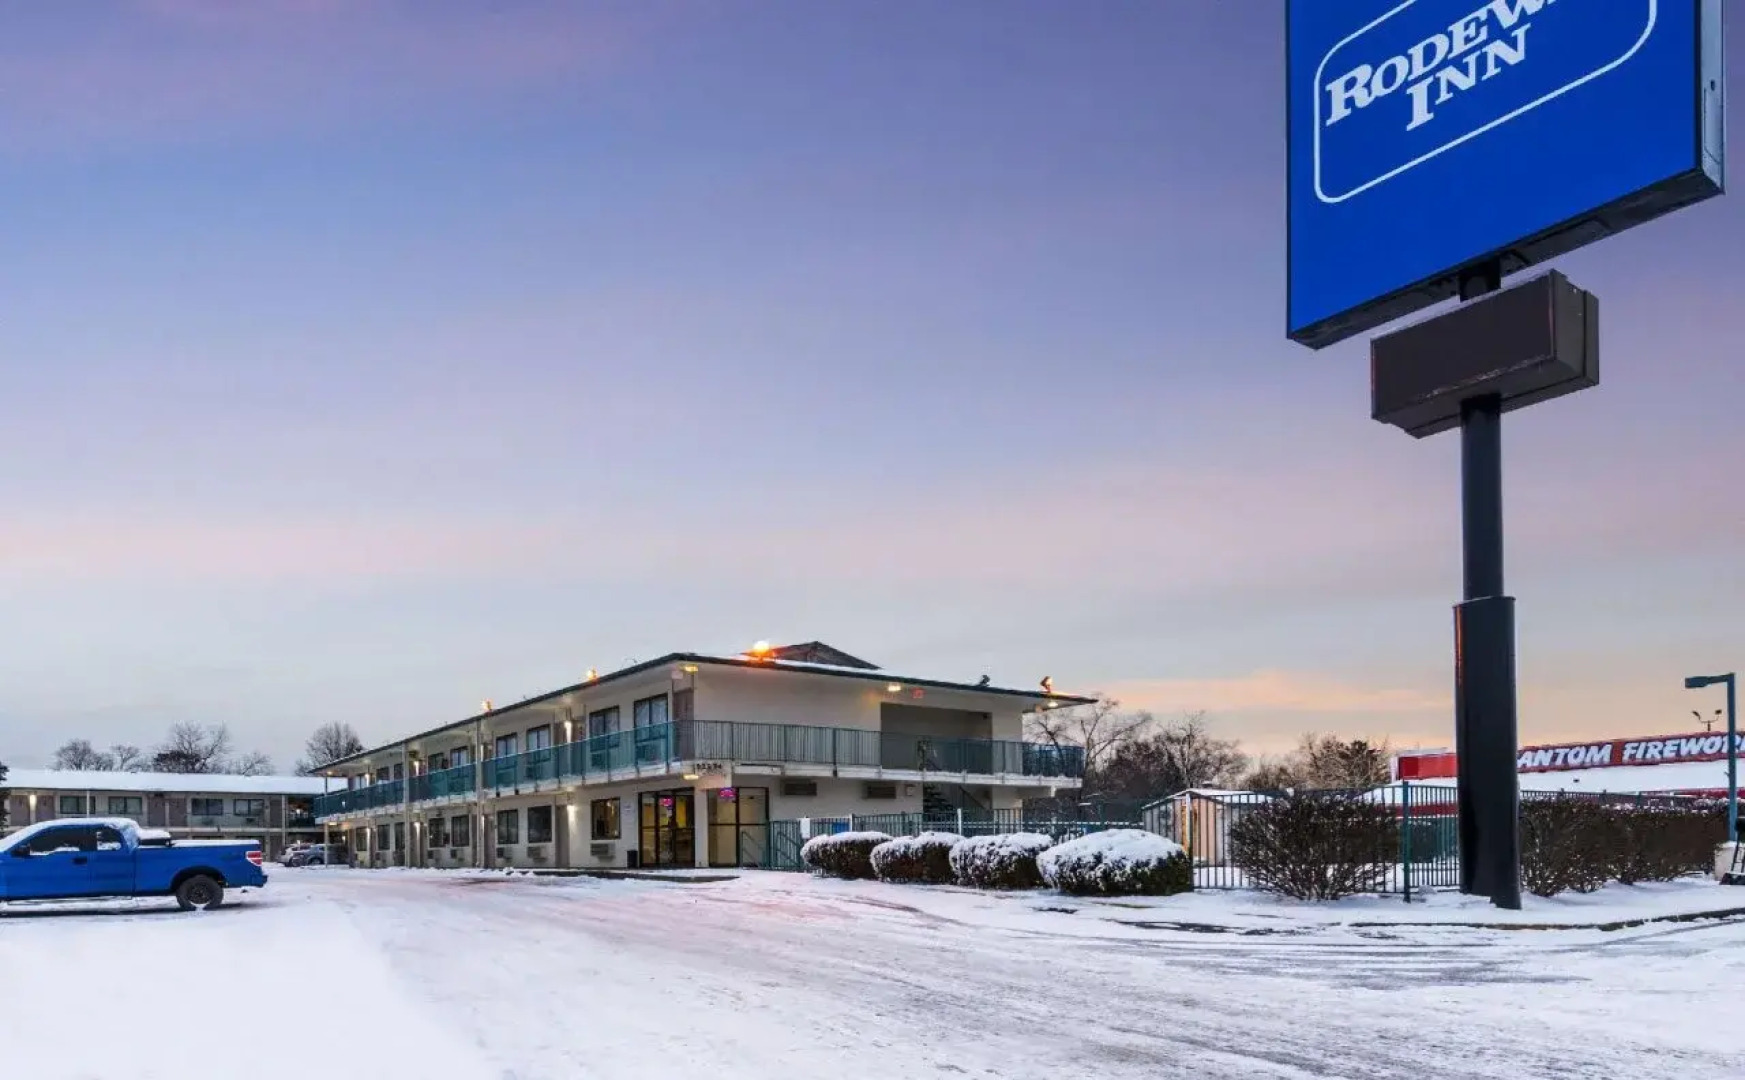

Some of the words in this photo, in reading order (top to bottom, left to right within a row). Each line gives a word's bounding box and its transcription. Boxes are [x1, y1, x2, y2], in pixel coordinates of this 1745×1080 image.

[1325, 0, 1557, 126] RODEW
[1406, 23, 1532, 131] INN
[1516, 743, 1613, 769] ANTOM
